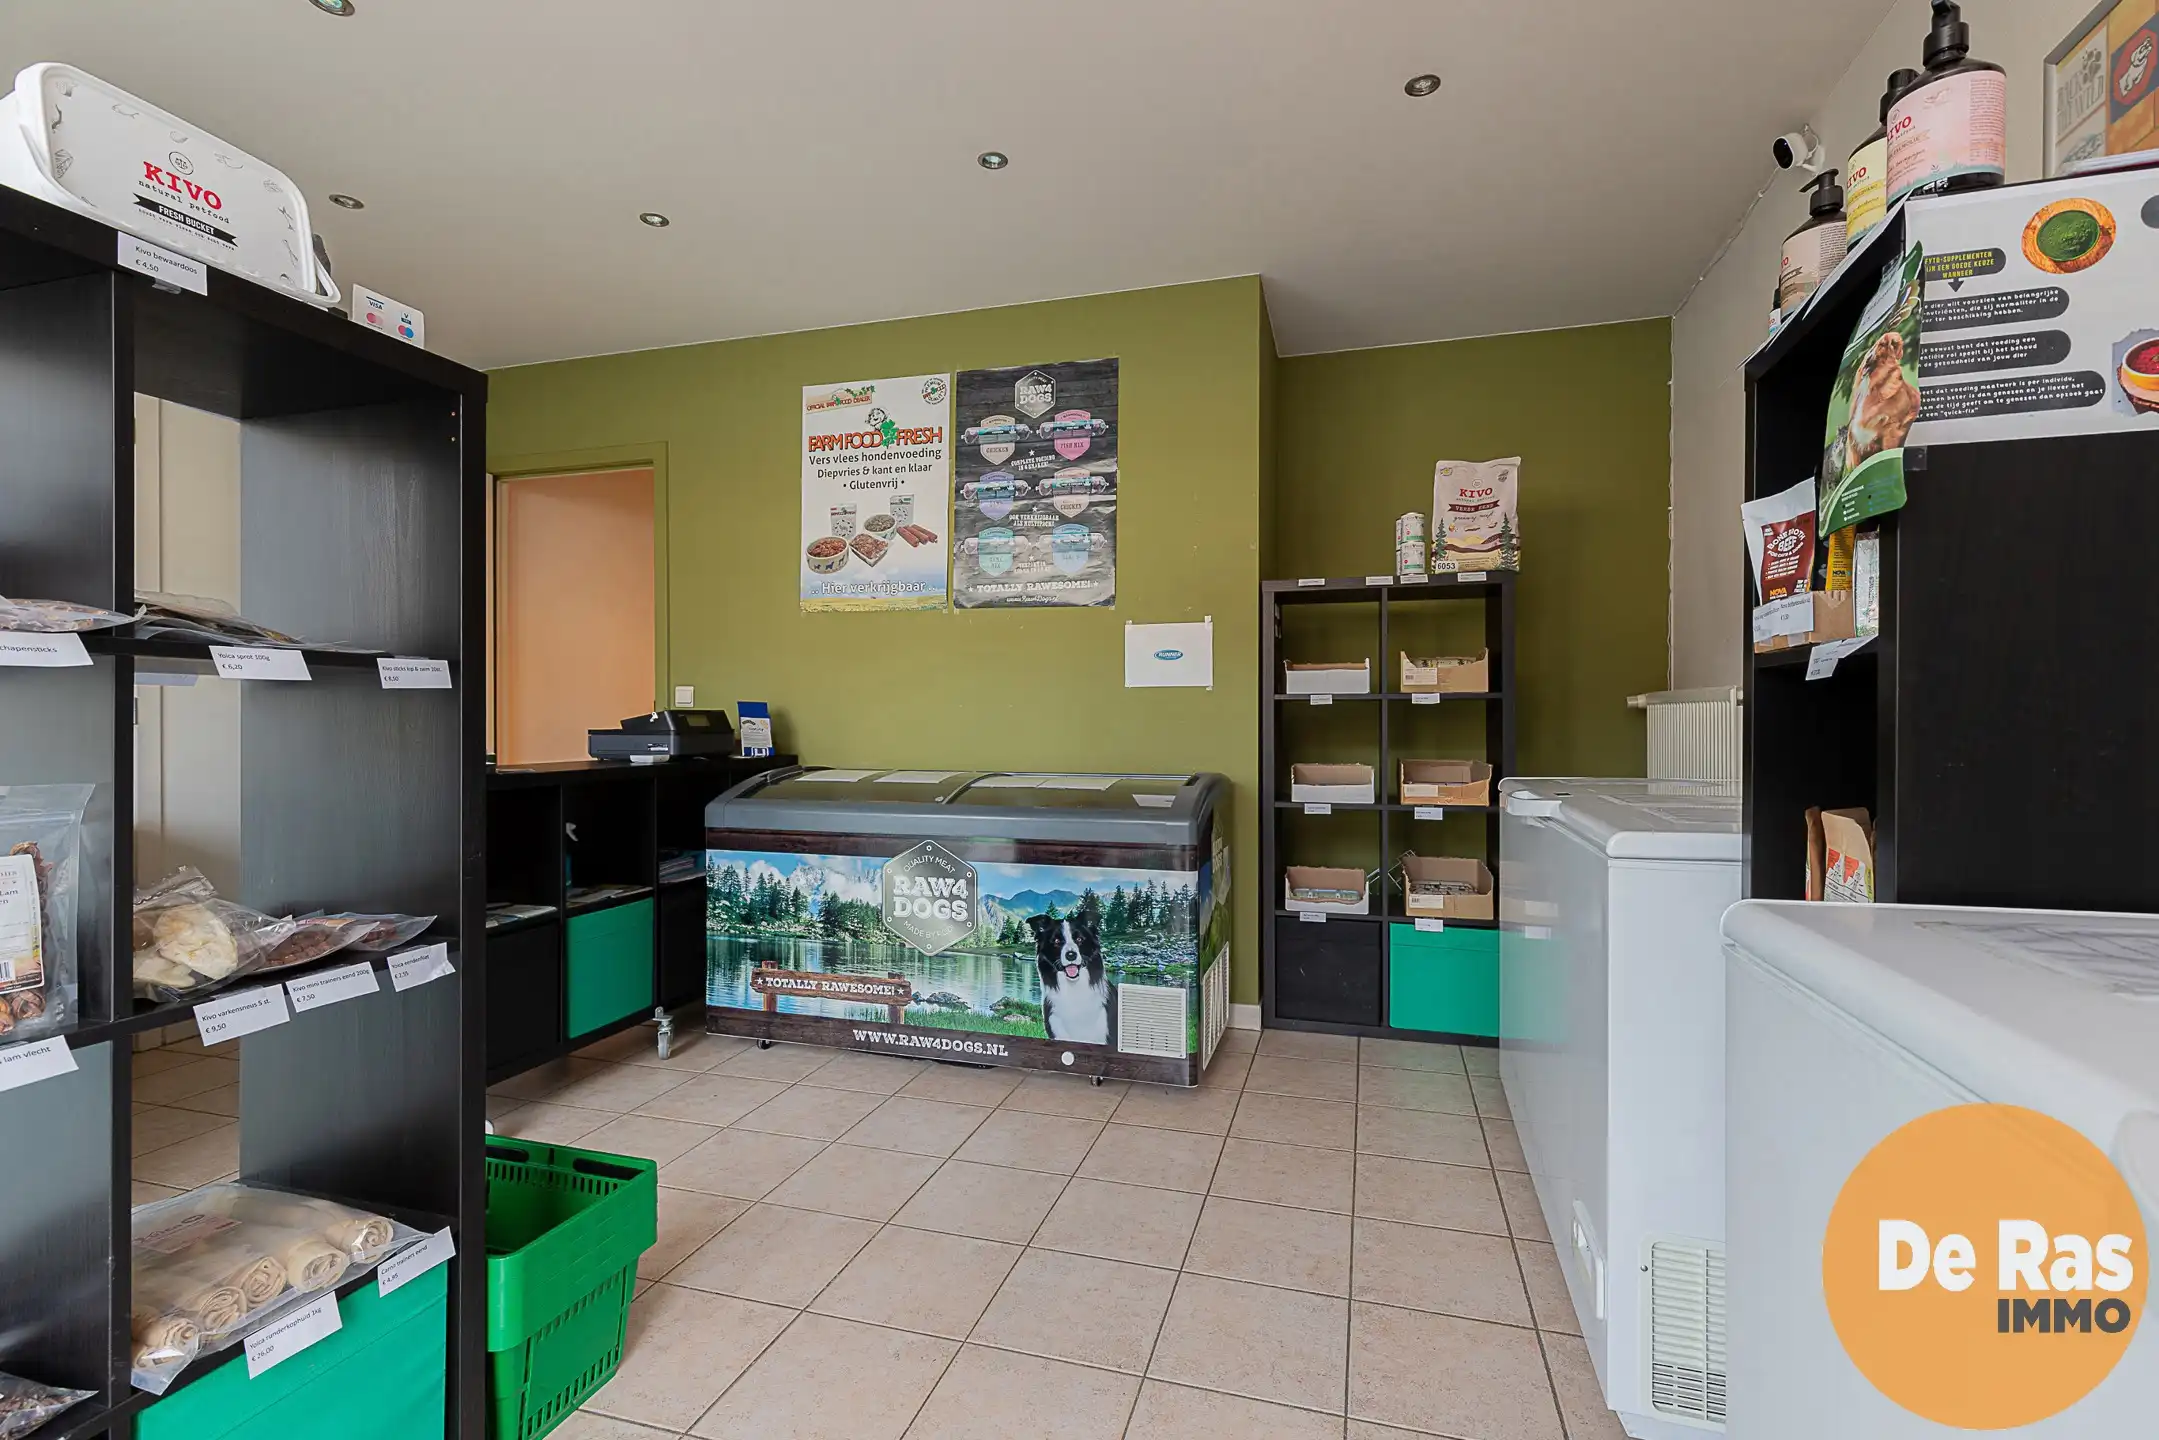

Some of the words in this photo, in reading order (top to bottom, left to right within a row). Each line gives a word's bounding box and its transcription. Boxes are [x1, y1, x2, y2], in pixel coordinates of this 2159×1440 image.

[1886, 116, 1912, 141] IVO
[143, 161, 222, 210] KIVO
[138, 180, 182, 204] natural
[188, 202, 230, 224] petfood
[158, 205, 184, 222] FRESH
[186, 215, 214, 234] BUCKET
[135, 245, 152, 256] Kivo
[152, 252, 198, 274] bewaardoos
[1924, 252, 1992, 264] FYTO-SUPPLEMENTEN
[1937, 263, 1950, 272] EEN
[1952, 260, 1972, 270] GOEDE
[1974, 258, 1994, 268] KEUZE
[142, 262, 159, 272] 4,50
[1942, 269, 1974, 278] WANNEER
[1962, 296, 1995, 305] voorzien
[2014, 289, 2059, 300] belangrijke
[1996, 298, 2036, 308] normaliter
[368, 300, 382, 310] VISA
[1948, 312, 1992, 321] beschikking
[1994, 307, 2024, 315] hebben.
[1991, 338, 2020, 347] voeding
[1959, 349, 1981, 357] speelt
[1934, 358, 1975, 368] gezondheid
[1019, 384, 1053, 396] RAW4
[1950, 385, 1979, 393] voeding
[1980, 381, 2017, 390] maatwerk
[2027, 379, 2040, 387] per
[1993, 388, 2024, 397] genezen
[2038, 386, 2045, 394] je
[1019, 392, 1053, 404] DOGS
[1962, 400, 1981, 408] geeft
[2006, 395, 2036, 404] genezen
[2056, 391, 2082, 400] opzoek
[2084, 388, 2103, 397] gaat
[806, 402, 825, 411] OFFICIAL
[1940, 408, 1979, 419] "quick-fix"
[896, 426, 942, 446] FRESH
[809, 455, 831, 465] Vers
[833, 453, 859, 463] vlees
[862, 447, 942, 462] hondenvoeding
[817, 468, 860, 479] Diepvries
[862, 466, 870, 475] &
[872, 465, 892, 474] kant
[894, 465, 906, 473] en
[908, 463, 932, 472] klaar
[849, 479, 898, 490] Glutenvrij
[1459, 488, 1493, 498] KIVO
[1767, 531, 1788, 550] BONE
[1778, 536, 1797, 552] BEEF
[822, 582, 847, 594] Hier
[850, 580, 926, 596] verkrijgbaar
[976, 583, 1024, 592] TOTALLY
[1026, 580, 1091, 591] RAWESOME!
[1770, 587, 1788, 596] NOVA
[0, 645, 58, 653] chapensticks
[904, 855, 934, 872] QUALITY
[934, 856, 956, 873] MEAT
[893, 876, 969, 900] RAW4
[893, 896, 968, 922] DOGS
[904, 920, 925, 937] MADE
[926, 930, 935, 939] BY
[292, 984, 306, 993] Kivo
[306, 980, 319, 989] mini
[320, 975, 342, 987] trainers
[342, 972, 356, 982] eend
[356, 968, 370, 978] 200g
[765, 977, 818, 990] TOTALLY
[821, 980, 895, 996] RAWESOME!
[302, 993, 316, 1002] 7,50
[202, 1013, 217, 1022] Kivo
[218, 1001, 258, 1017] varkensneus
[211, 1023, 226, 1033] 9,50
[852, 1029, 1008, 1056] WWW.RAW4DOGS.NL
[4, 1054, 21, 1062] lam
[23, 1046, 51, 1058] vlecht
[396, 1253, 415, 1266] trainers
[415, 1244, 428, 1255] eend
[266, 1313, 311, 1341] runderkophuid
[312, 1307, 322, 1316] 1kg
[257, 1345, 275, 1359] 26,00
